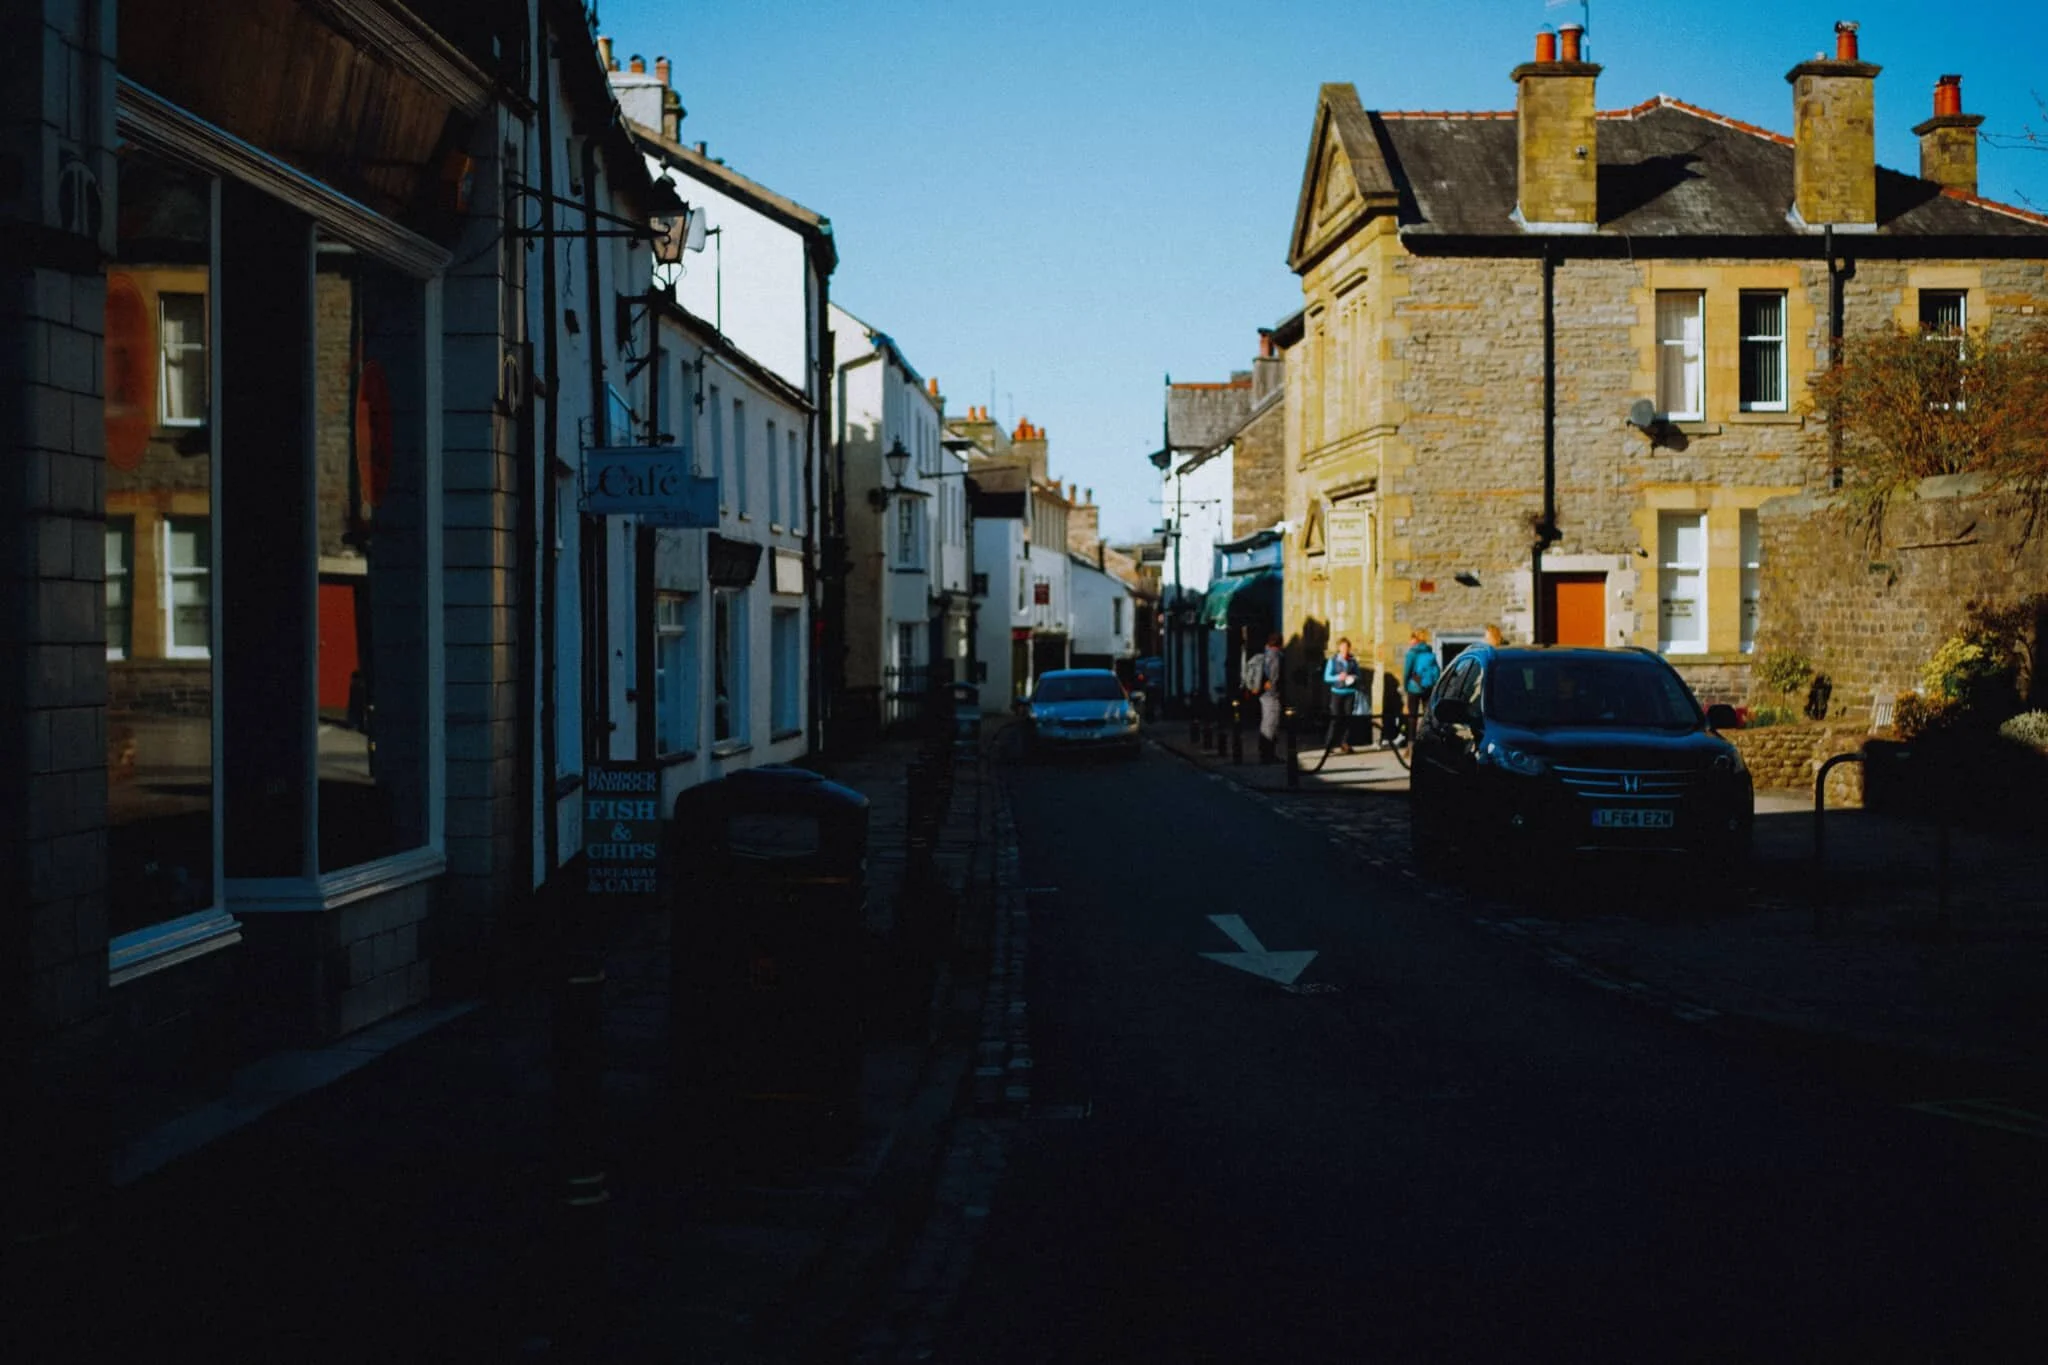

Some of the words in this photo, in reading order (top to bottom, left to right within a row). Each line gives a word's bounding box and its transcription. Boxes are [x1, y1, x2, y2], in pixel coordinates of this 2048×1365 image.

[600, 463, 677, 497] Café
[587, 800, 656, 820] FISH
[1601, 811, 1638, 825] LF64
[611, 822, 632, 841] &
[587, 843, 656, 859] CHIPS
[586, 879, 602, 892] &
